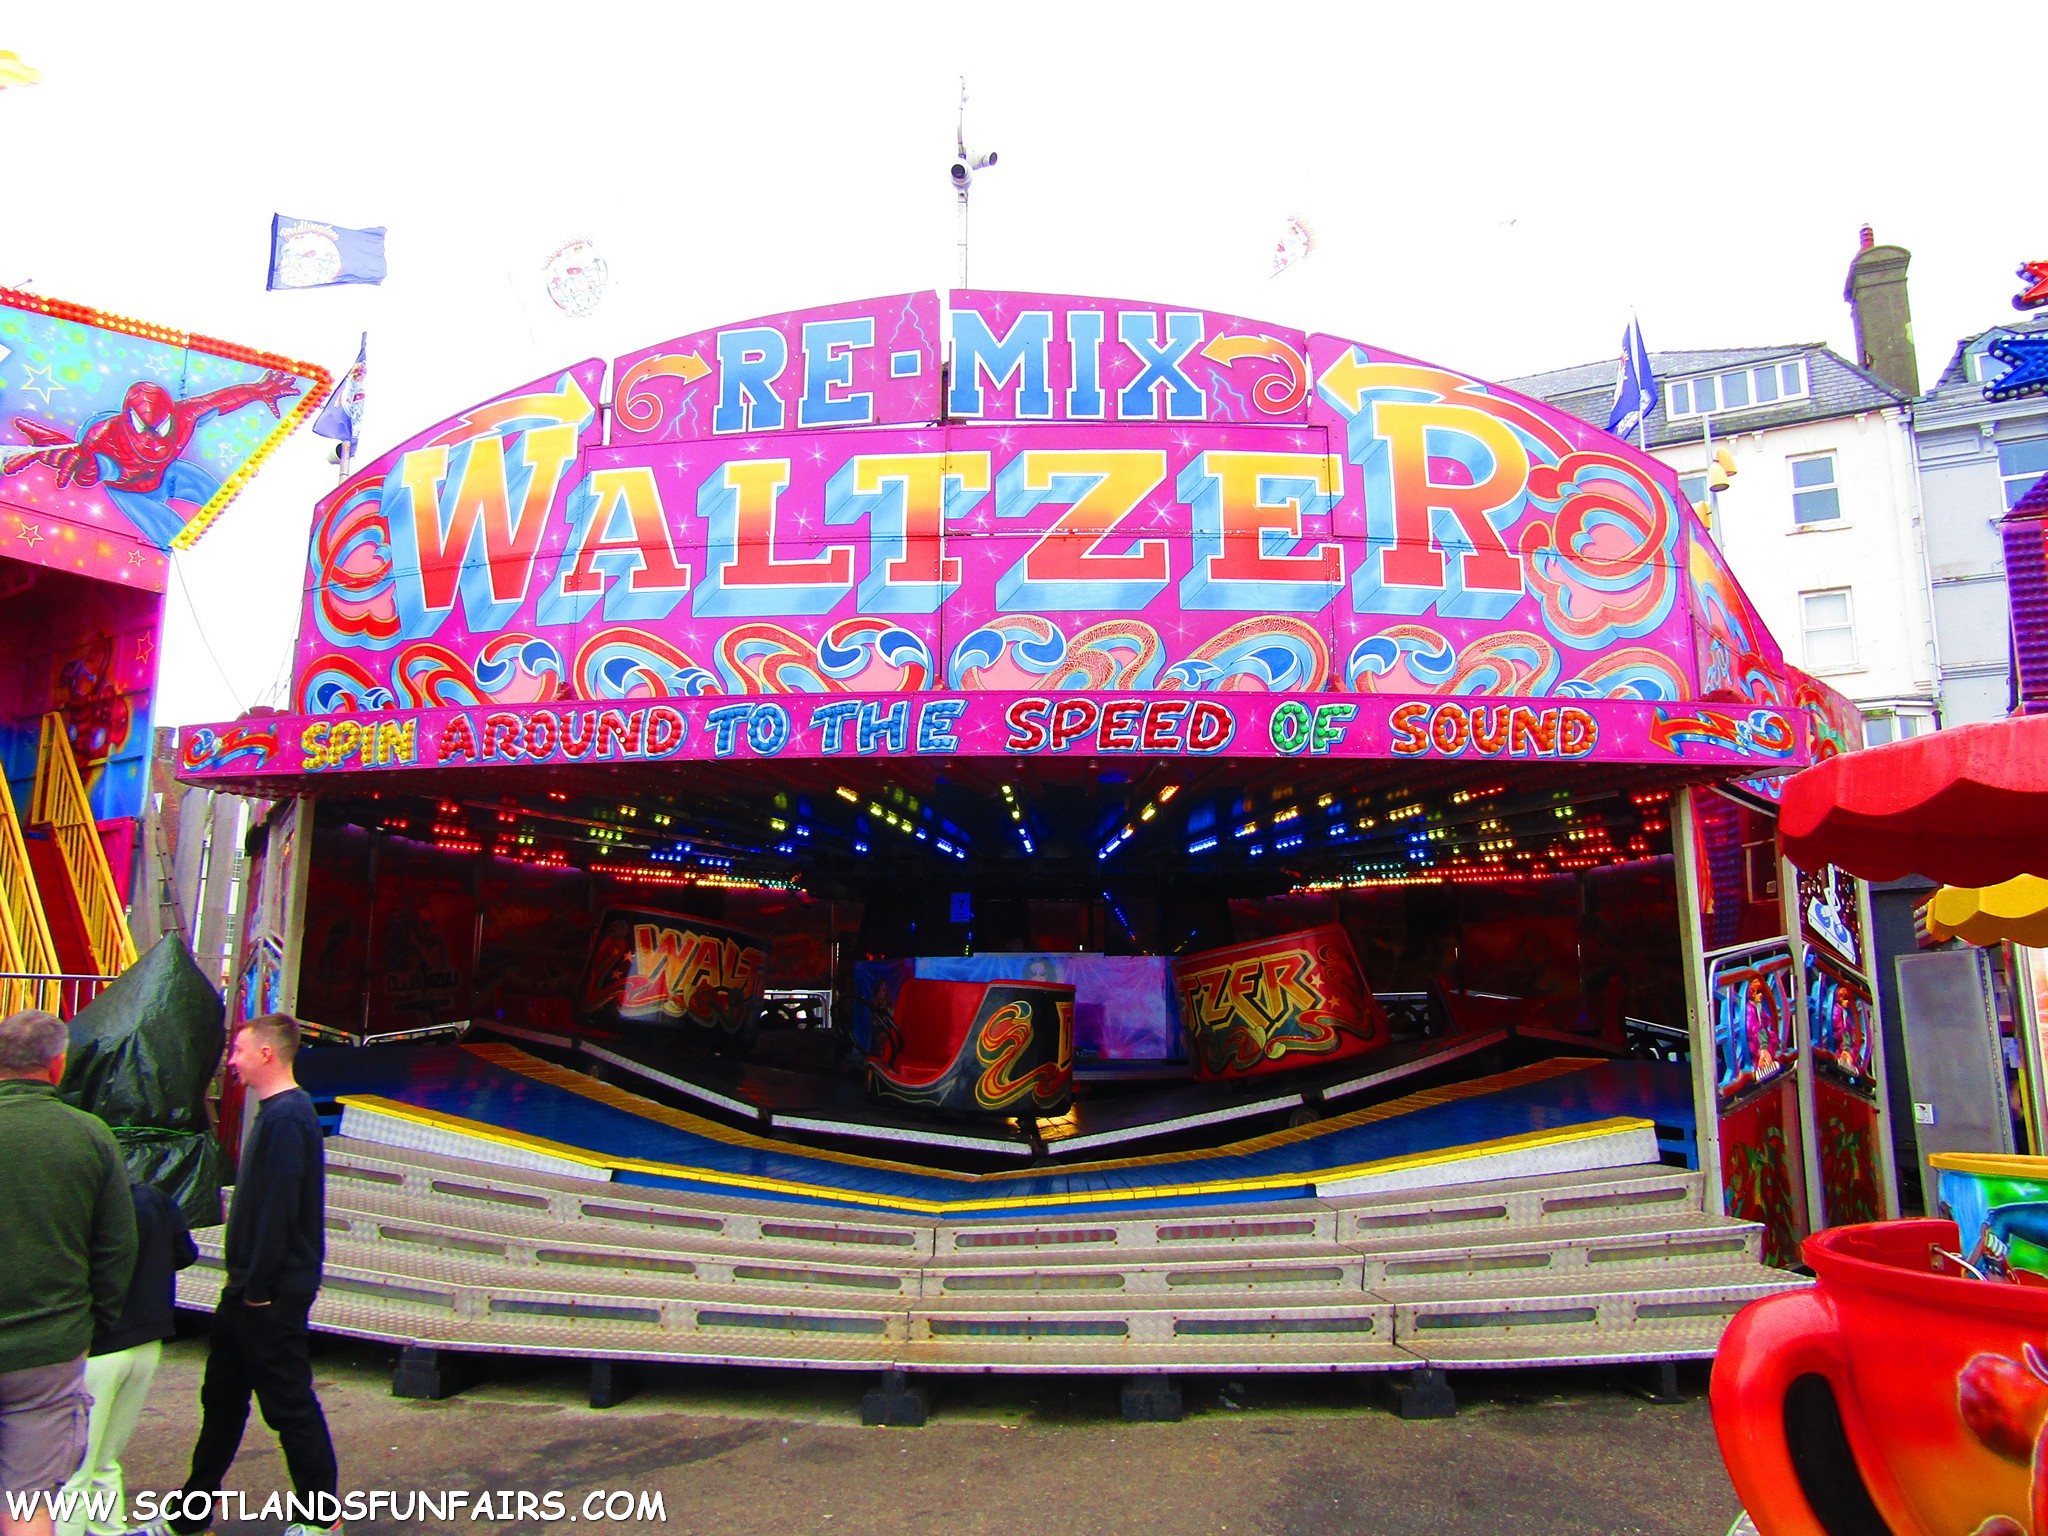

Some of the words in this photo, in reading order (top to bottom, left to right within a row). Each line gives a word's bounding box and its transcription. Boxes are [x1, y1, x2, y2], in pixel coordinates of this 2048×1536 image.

[380, 400, 1527, 640] WALTZER
[301, 717, 418, 772] SPIN
[437, 705, 690, 768] AROUND
[704, 702, 786, 757] TO
[808, 699, 970, 757] THE
[1004, 699, 1238, 756] SPEED
[1269, 700, 1360, 757] OF
[1389, 702, 1600, 759] SOUND
